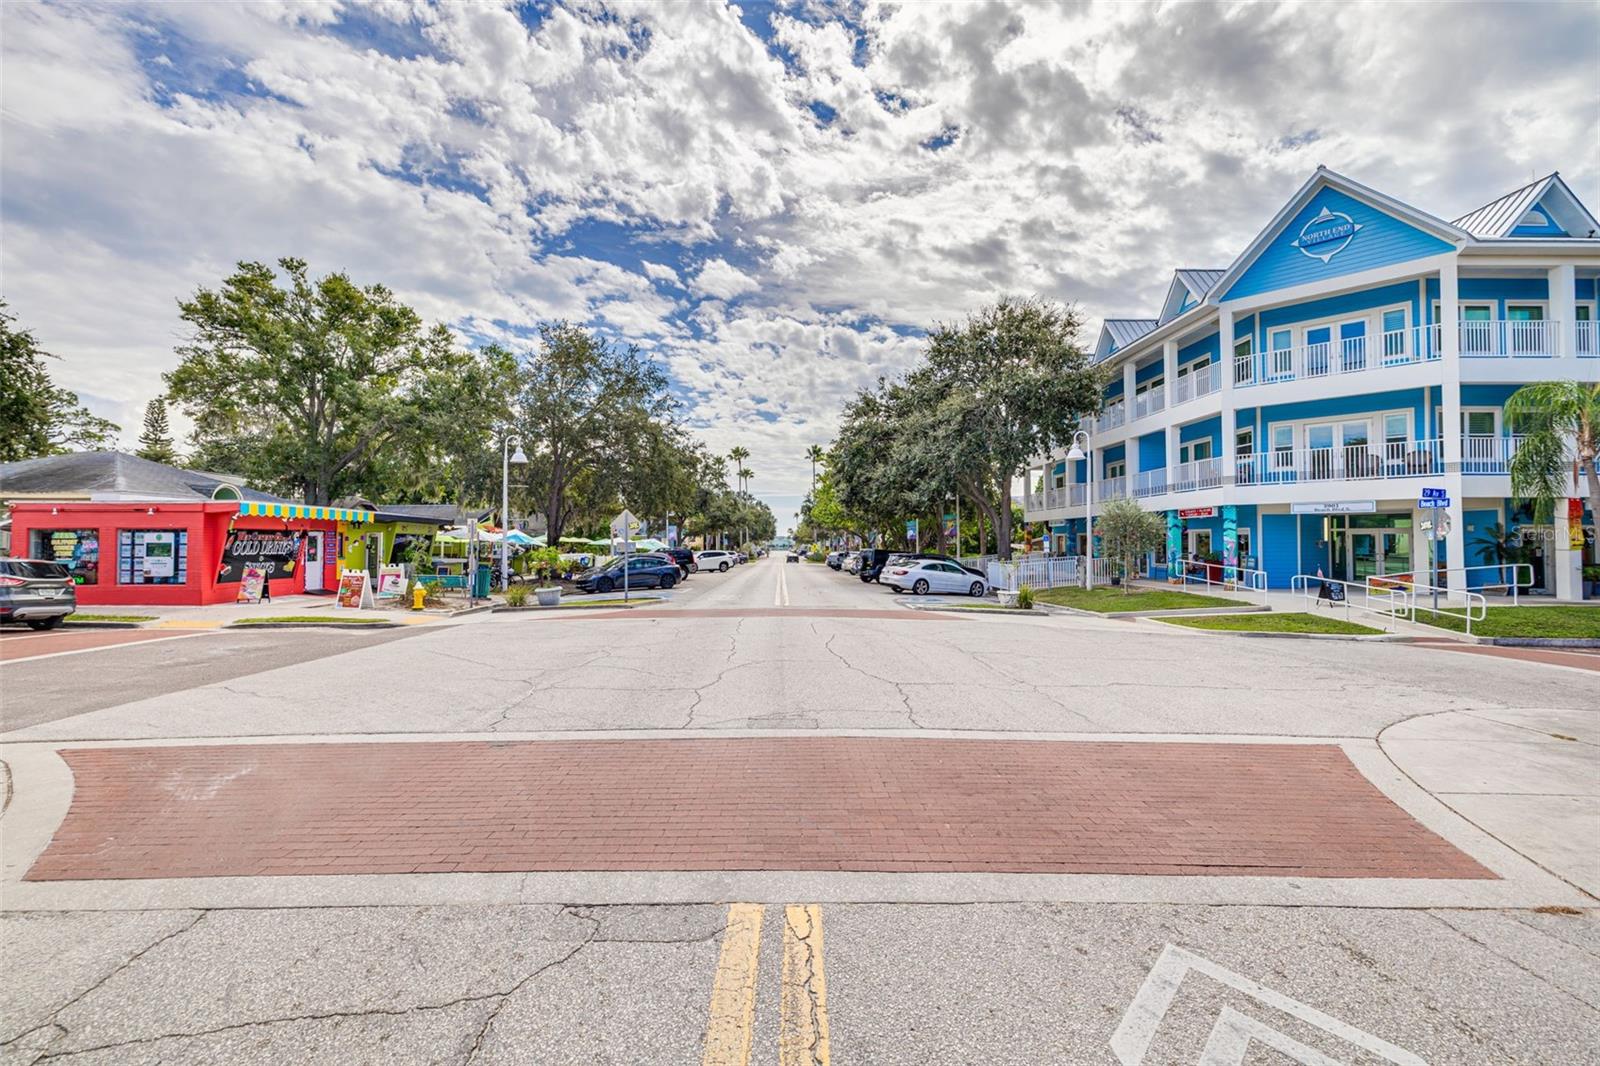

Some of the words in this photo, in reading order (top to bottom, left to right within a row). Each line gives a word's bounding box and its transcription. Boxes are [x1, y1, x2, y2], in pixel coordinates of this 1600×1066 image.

[1302, 229, 1331, 241] NORTH
[1332, 223, 1350, 234] END
[1421, 500, 1435, 508] Beach
[1437, 499, 1449, 507] Blvd
[232, 540, 260, 556] COLD
